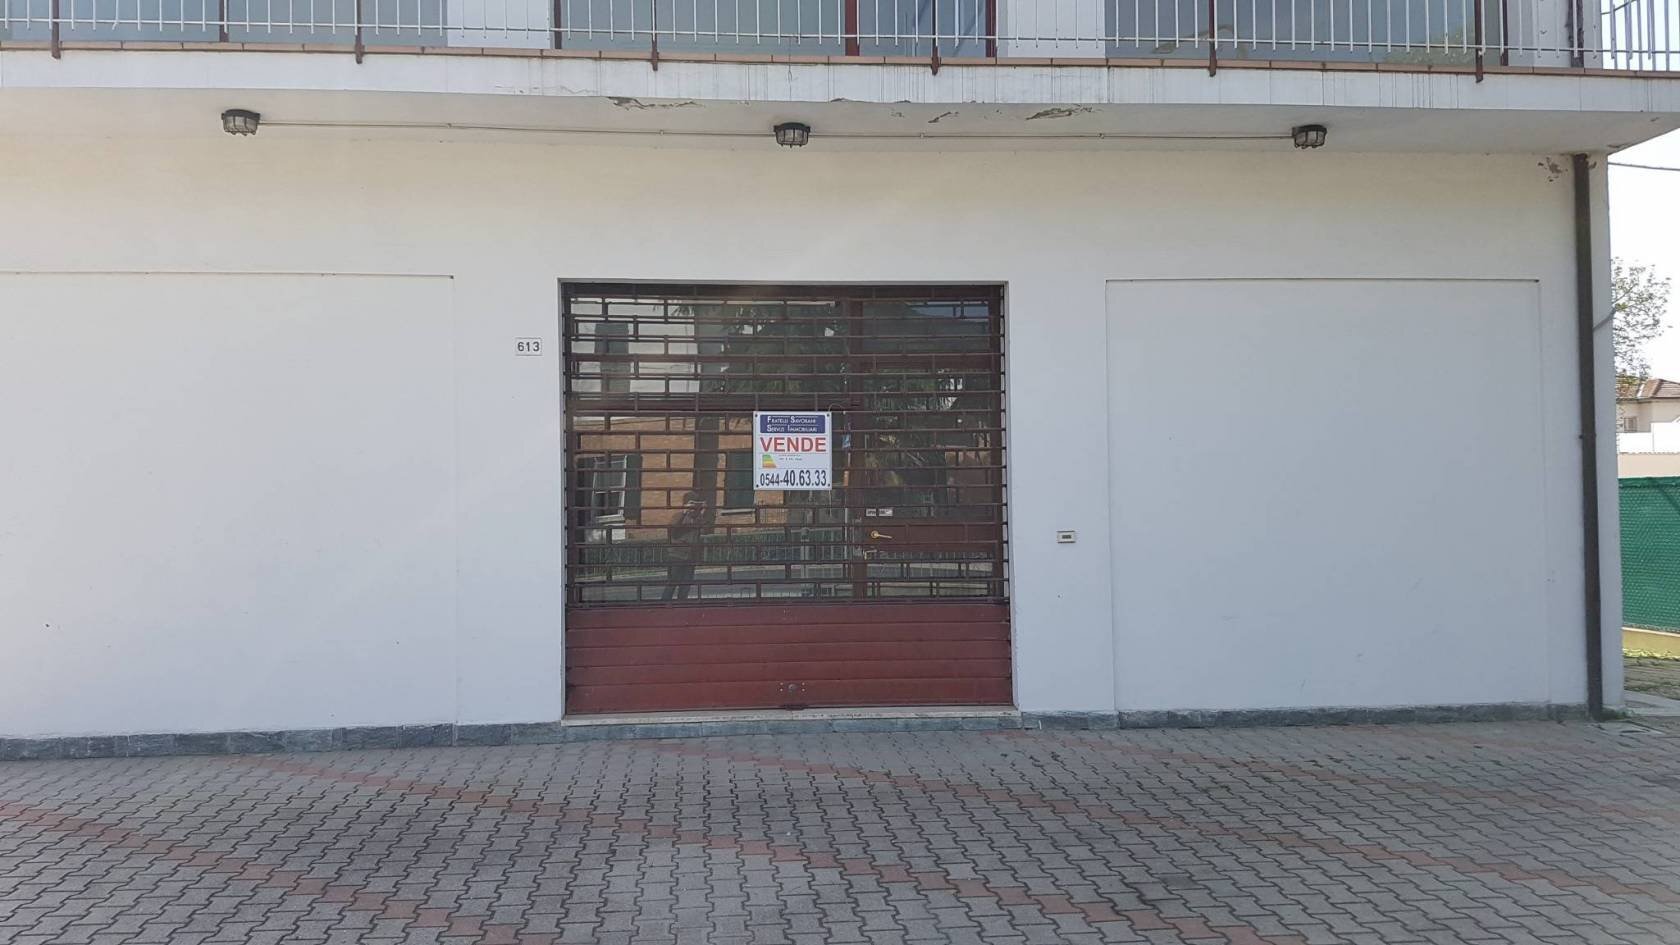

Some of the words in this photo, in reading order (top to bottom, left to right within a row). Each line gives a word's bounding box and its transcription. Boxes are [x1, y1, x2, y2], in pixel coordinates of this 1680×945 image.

[517, 341, 540, 352] 613
[760, 437, 826, 452] VENDE
[760, 470, 827, 487] 0544-40.63.33
